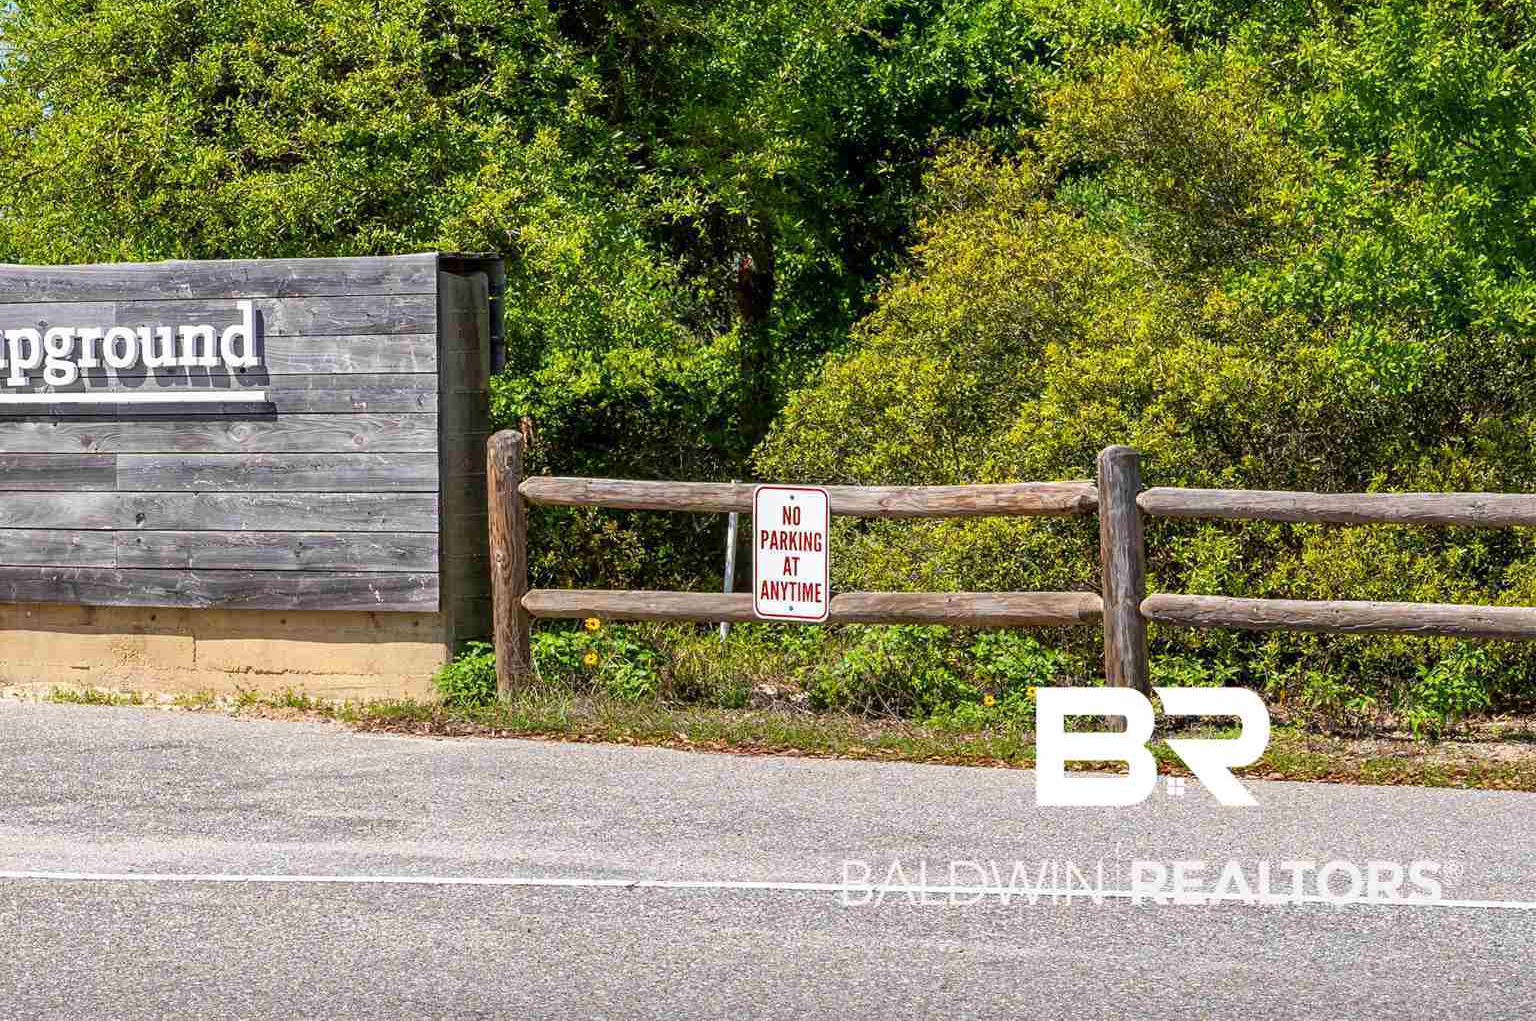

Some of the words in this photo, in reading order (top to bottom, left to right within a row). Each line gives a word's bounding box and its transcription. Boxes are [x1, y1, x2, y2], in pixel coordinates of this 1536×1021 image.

[782, 505, 801, 526] NO
[760, 529, 823, 552] PARKING
[782, 556, 801, 577] AT
[760, 579, 823, 603] ANYTIME
